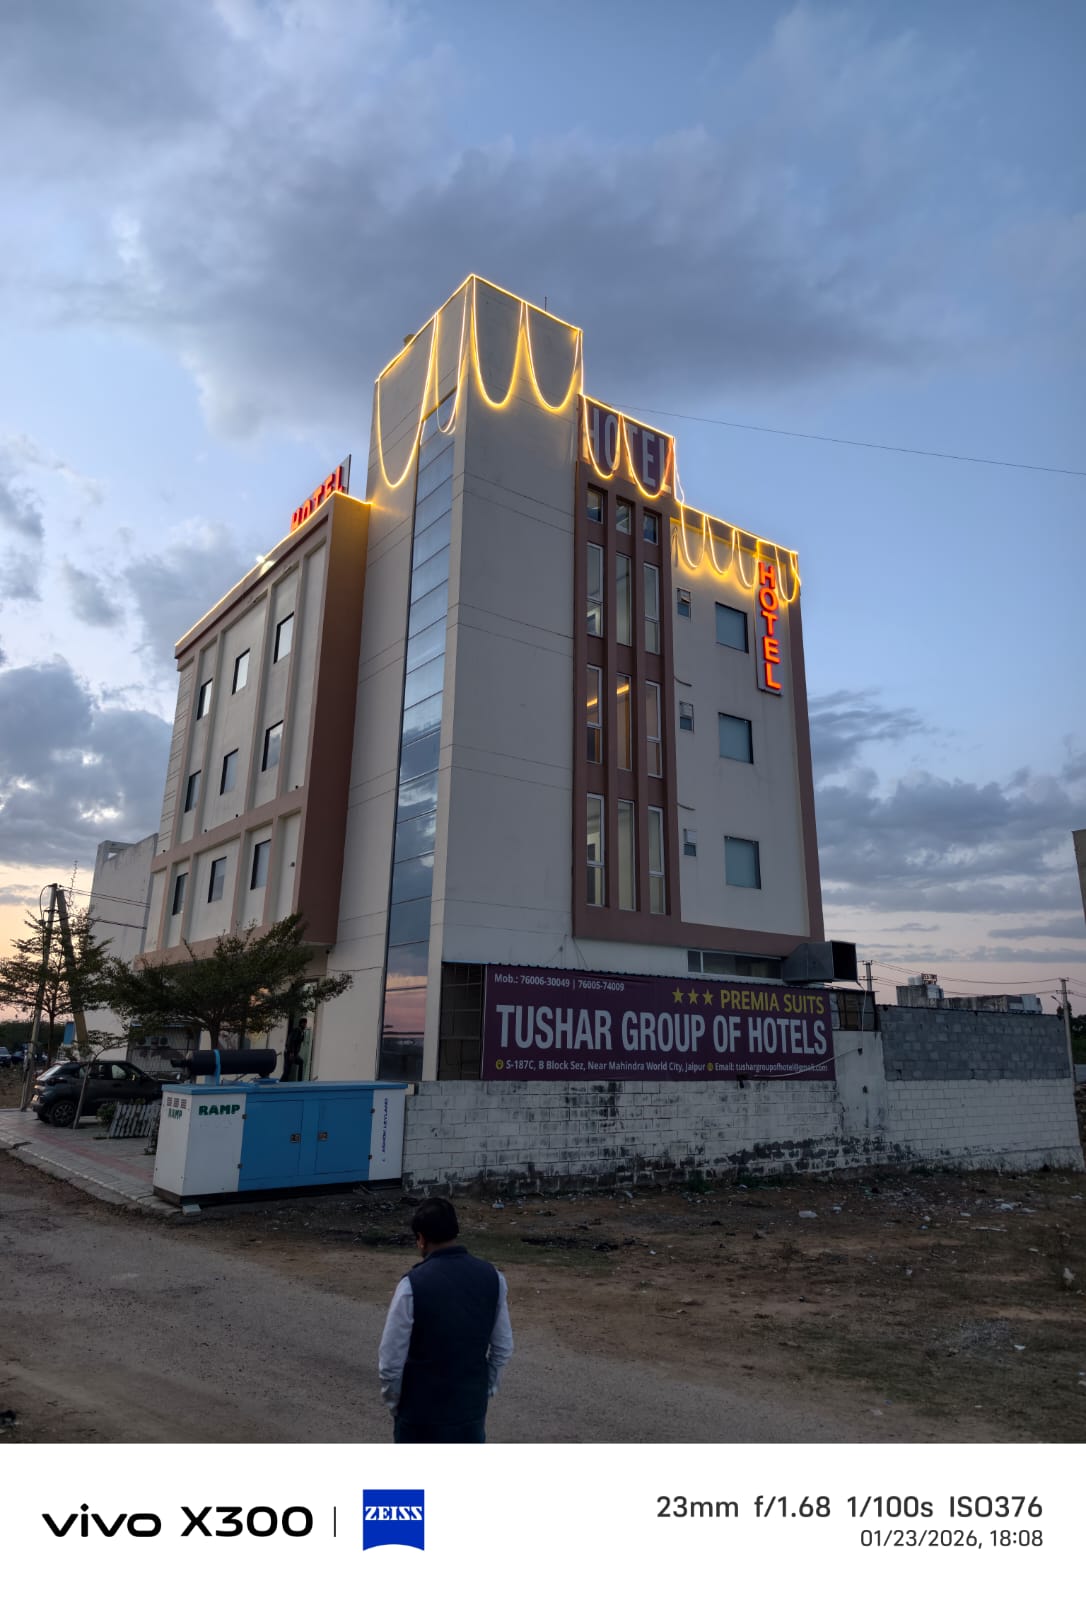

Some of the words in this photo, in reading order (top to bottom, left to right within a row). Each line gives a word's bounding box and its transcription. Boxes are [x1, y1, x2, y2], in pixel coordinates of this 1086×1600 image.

[583, 407, 671, 494] HOTEL
[758, 562, 782, 691] HOTEL
[494, 973, 518, 984] Mob.:
[520, 975, 570, 988] 76006-30049
[720, 989, 780, 1012] PREMIA
[783, 994, 825, 1015] SUITS
[496, 1004, 613, 1050] TUSHAR
[622, 1009, 706, 1053] GROUP
[713, 1014, 742, 1053] OF
[748, 1017, 827, 1055] HOTELS
[505, 1059, 536, 1071] S-187C,
[538, 1060, 545, 1070] B
[546, 1060, 569, 1070] Block
[570, 1060, 586, 1071] Sez,
[588, 1060, 607, 1070] Near
[609, 1060, 645, 1071] Mahindra
[646, 1061, 668, 1071] World
[669, 1061, 684, 1073] City,
[685, 1062, 706, 1073] Jaipur
[715, 1062, 734, 1072] Email:
[168, 1107, 183, 1120] RAMP
[198, 1104, 241, 1116] RAMP
